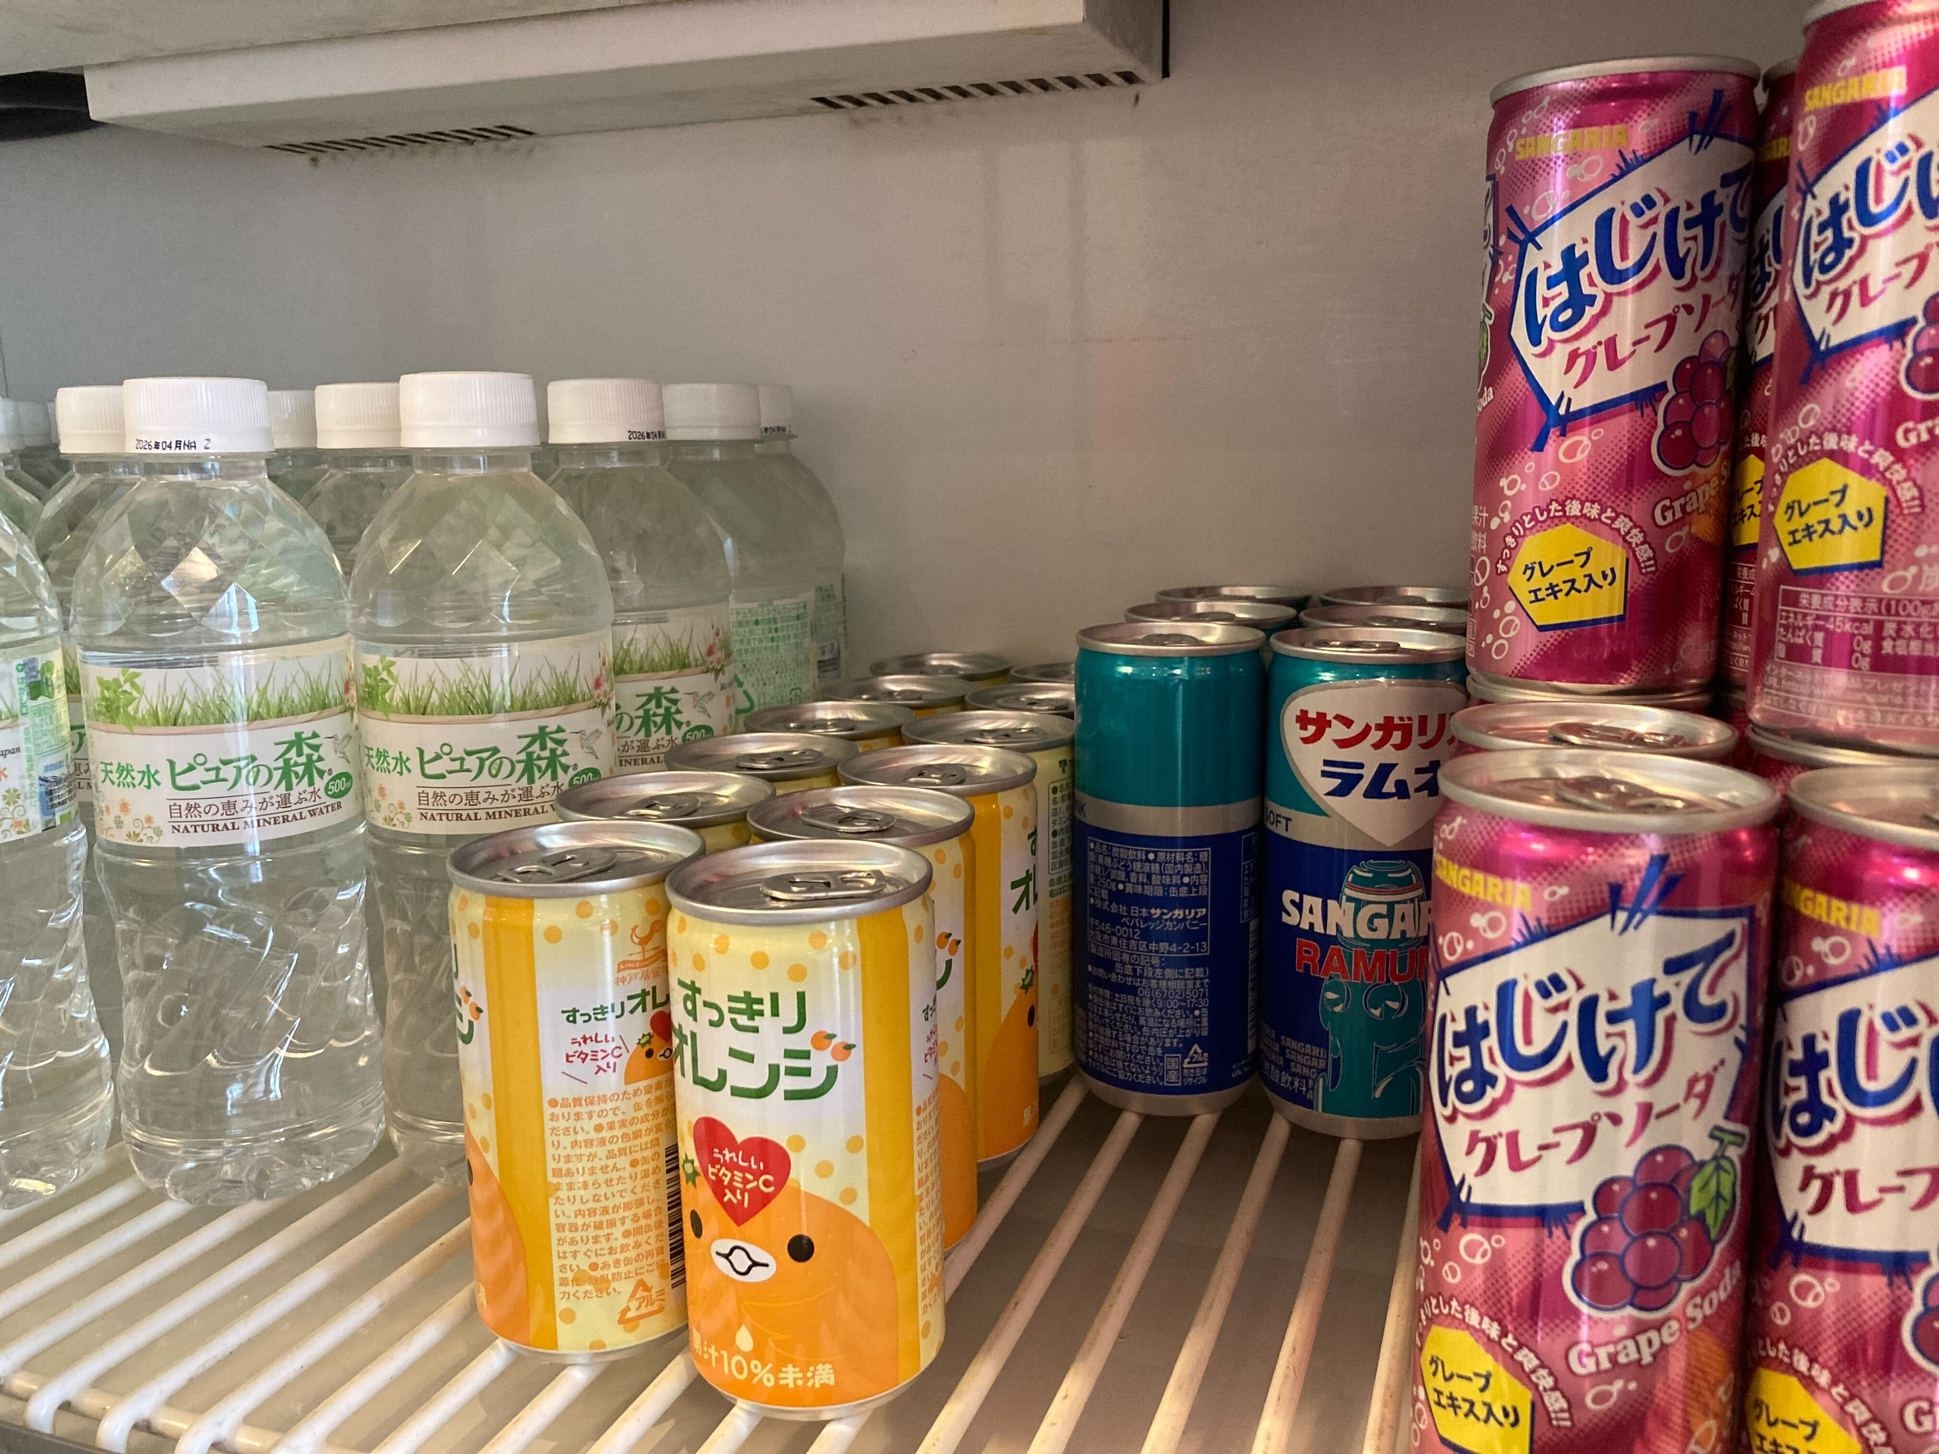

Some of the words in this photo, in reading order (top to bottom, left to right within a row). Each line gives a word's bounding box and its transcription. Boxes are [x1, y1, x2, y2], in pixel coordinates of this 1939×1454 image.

[1522, 547, 1593, 582] グレープ
[1528, 567, 1617, 604] エキス入り
[1296, 708, 1457, 751] サンガリ
[167, 731, 327, 792] ピュアの森
[364, 745, 411, 776] 天然水
[416, 724, 571, 782] ピュアの森
[620, 756, 664, 767] INERAL
[100, 761, 161, 791] 天然水
[168, 787, 322, 819] 自然の恵みが運ぶ水
[417, 781, 565, 808] 自然の恵みが運ぶ水
[171, 820, 240, 834] NATURAL
[243, 811, 307, 830] MINERAL
[309, 801, 343, 819] WATER
[419, 808, 482, 822] NATURAL
[484, 803, 547, 820] MINERAL
[677, 977, 808, 1034] すっきり
[1436, 929, 1738, 1108] はじけて
[565, 1046, 623, 1064] ビタミンC
[594, 1062, 617, 1075] 入り
[672, 1022, 839, 1101] オレンジ
[1465, 1057, 1726, 1178] グレープソーダ
[713, 1147, 764, 1170] うれしい
[707, 1162, 776, 1193] ビタミンC
[723, 1190, 749, 1209] 入り
[1568, 1319, 1681, 1376] Grape
[1685, 1260, 1742, 1330] Soda
[1429, 1353, 1493, 1394] グレープ
[1433, 1388, 1522, 1429] エキス入り
